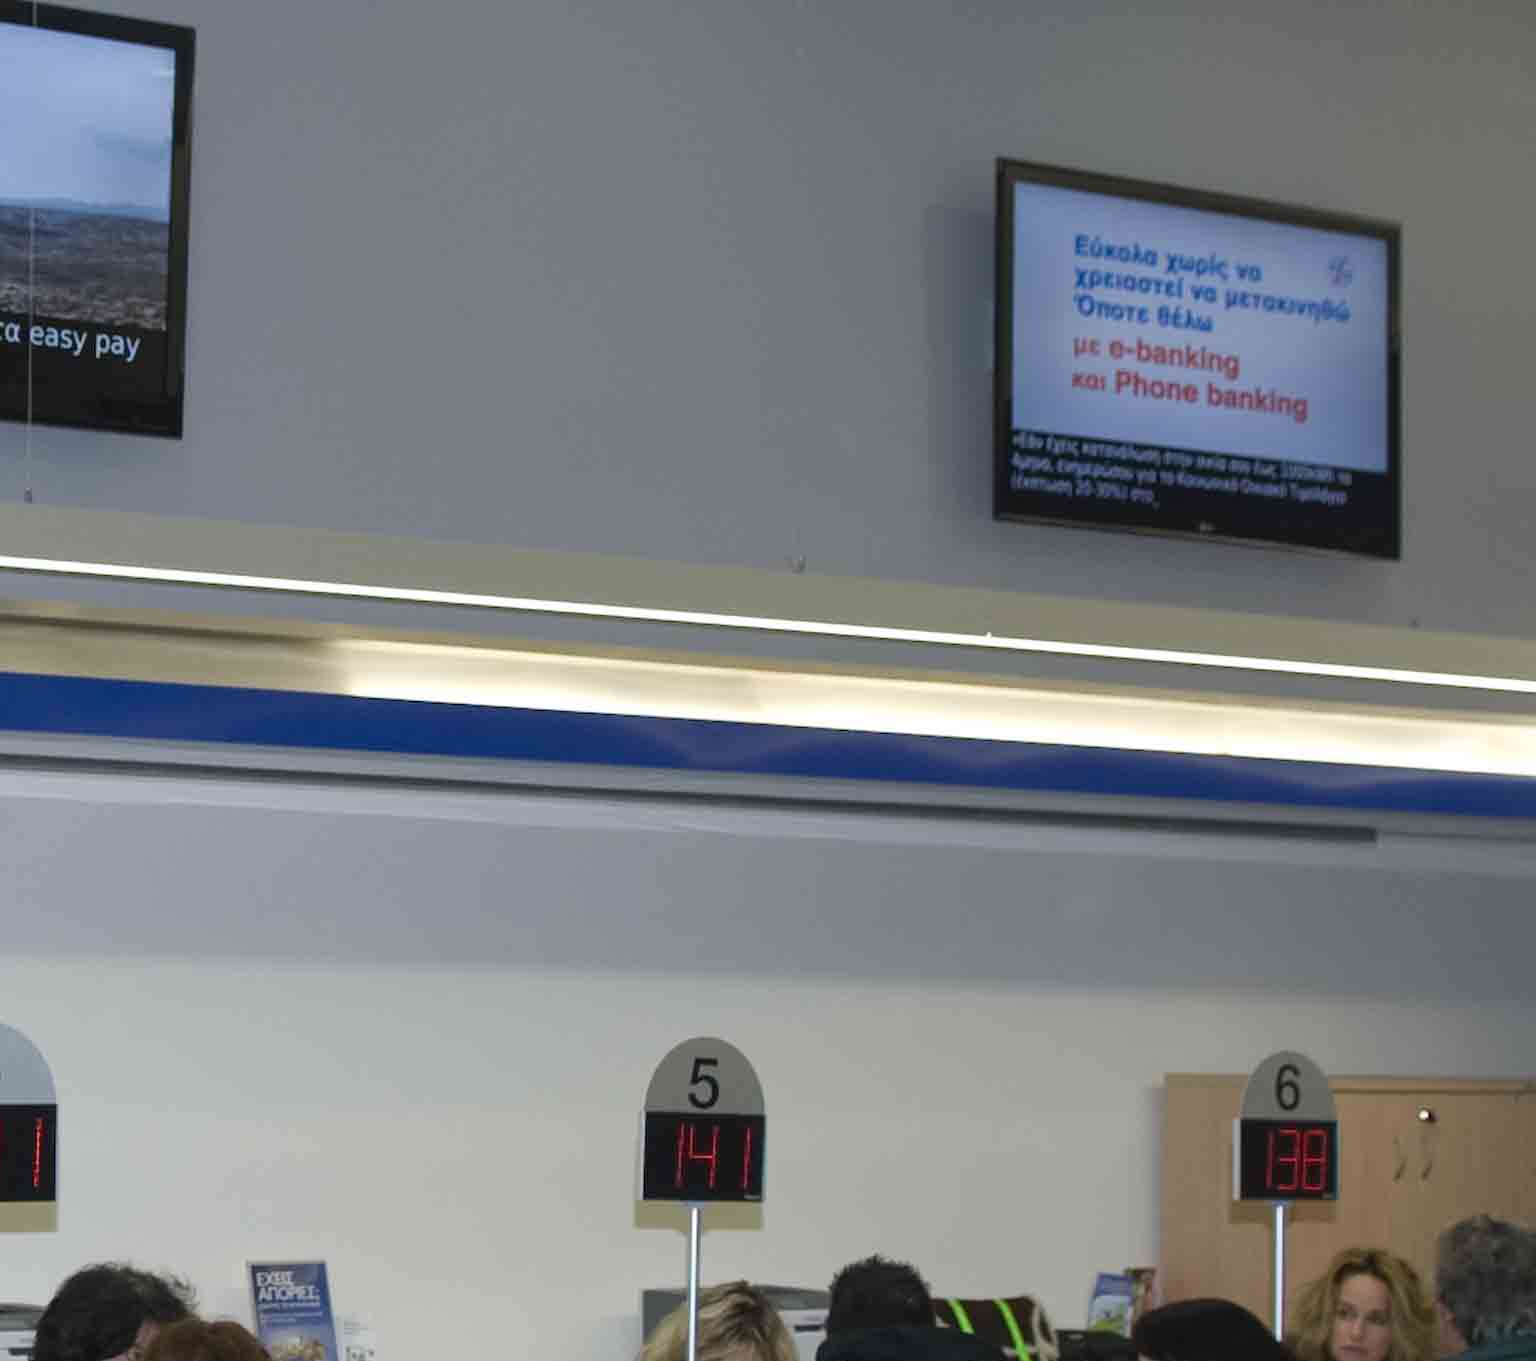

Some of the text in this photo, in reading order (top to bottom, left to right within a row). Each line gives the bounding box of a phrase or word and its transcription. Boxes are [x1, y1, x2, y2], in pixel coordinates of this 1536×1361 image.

[1074, 234, 1263, 282] Εύκολα χωρίς να
[1074, 268, 1184, 300] χρειαστεί
[1191, 285, 1218, 303] να
[1157, 305, 1214, 333] θέλω
[29, 324, 88, 356] easy
[95, 331, 141, 363] pay
[1073, 337, 1241, 381] με e-banking
[1072, 371, 1309, 423] και Phone banking
[688, 1057, 719, 1109] 5
[1275, 1064, 1300, 1111] 6
[676, 1123, 752, 1189] 141
[1265, 1128, 1327, 1190] 138
